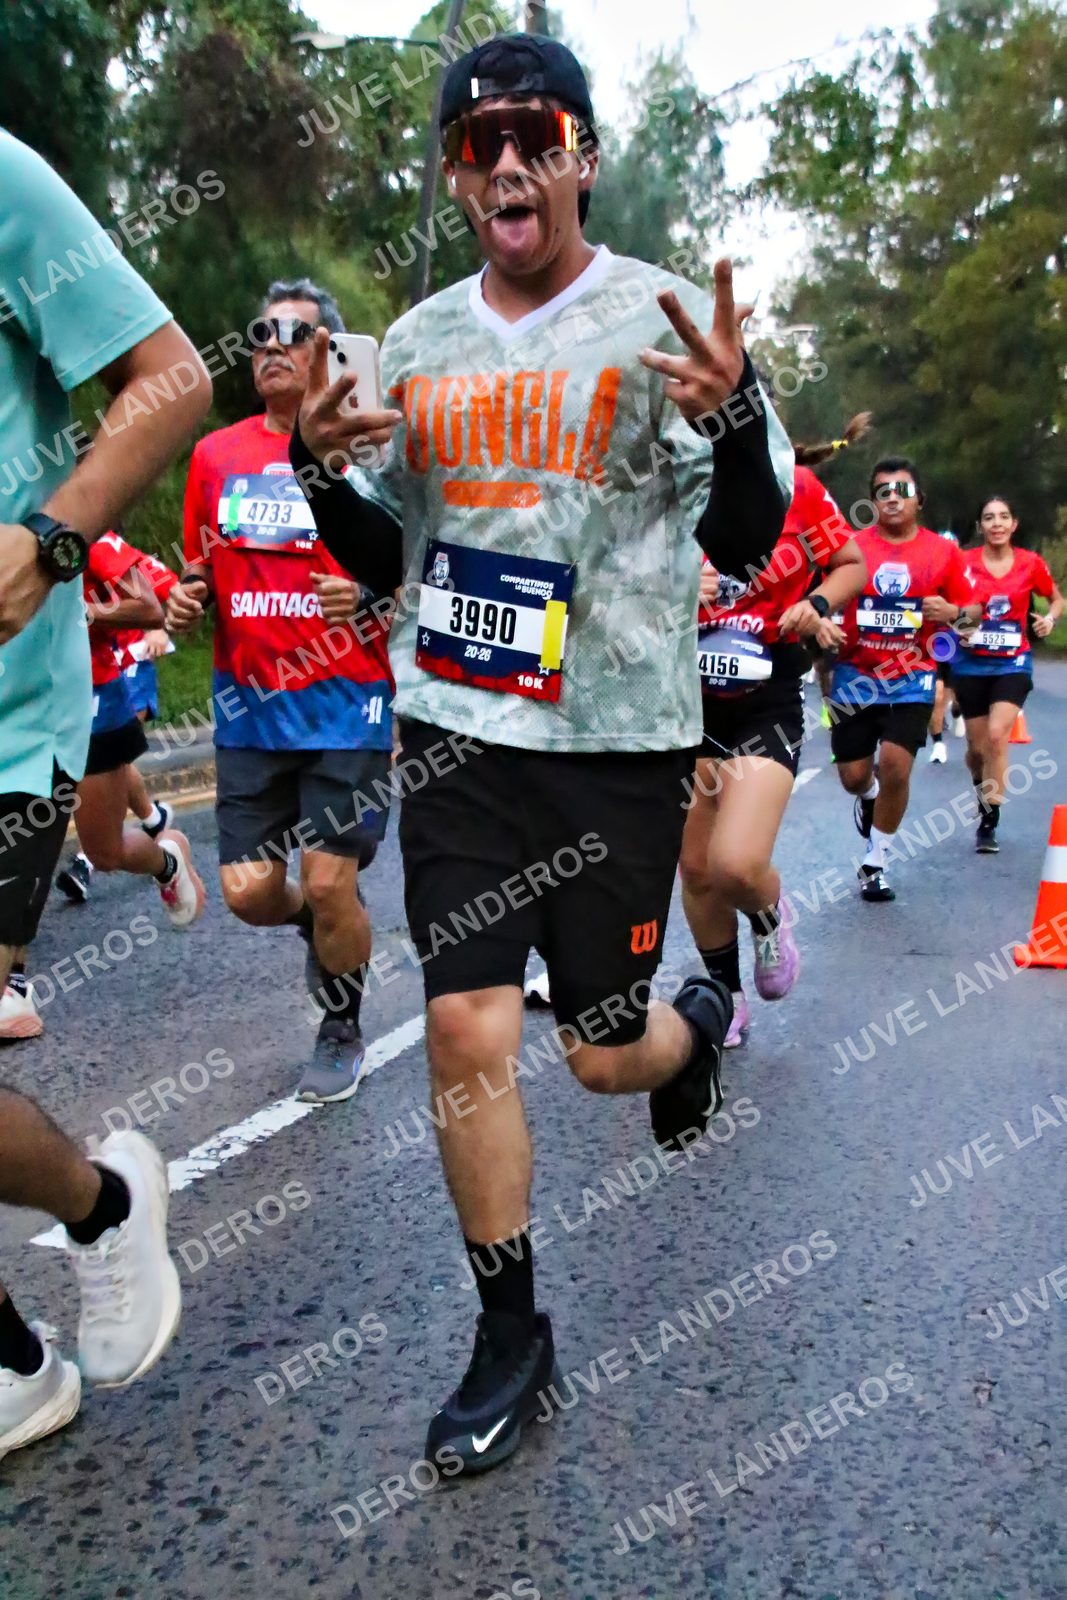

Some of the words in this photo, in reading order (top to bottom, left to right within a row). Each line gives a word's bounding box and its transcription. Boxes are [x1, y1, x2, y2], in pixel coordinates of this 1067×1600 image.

[247, 502, 293, 524] 4733
[450, 597, 517, 645] 3990
[874, 613, 903, 626] 5062
[464, 644, 492, 662] 20-26
[699, 654, 739, 677] 4156
[517, 675, 543, 690] 10K
